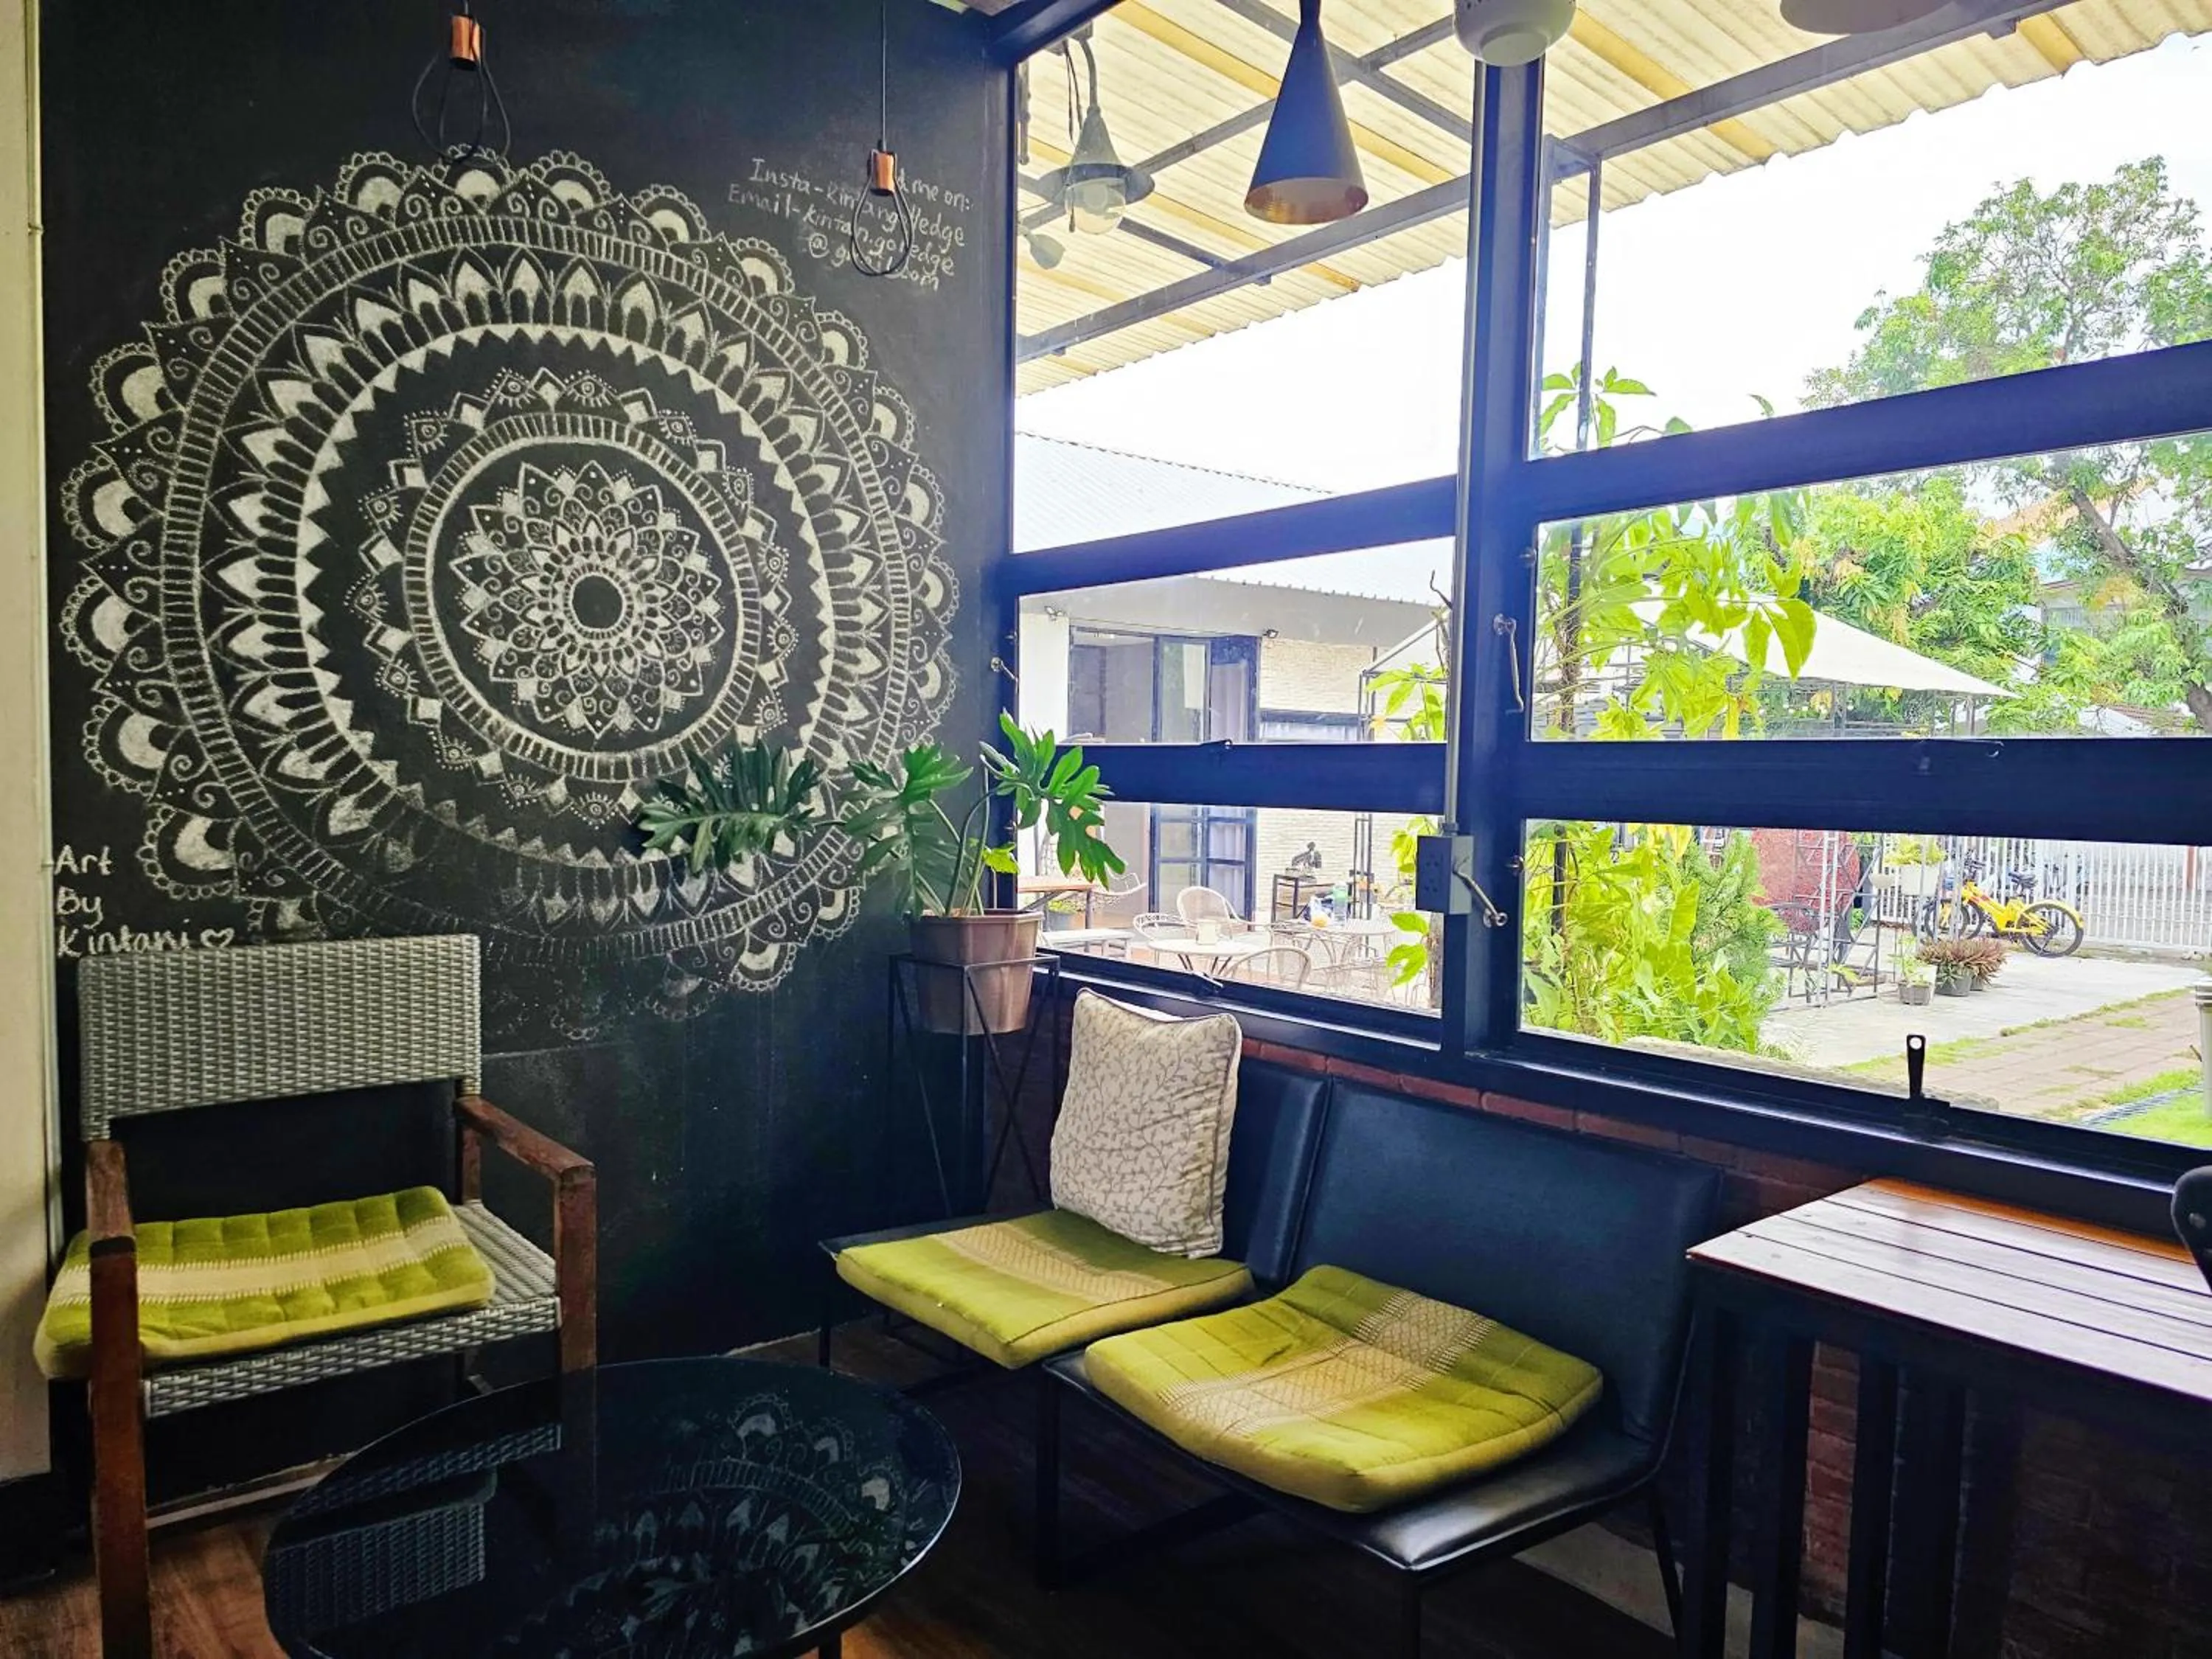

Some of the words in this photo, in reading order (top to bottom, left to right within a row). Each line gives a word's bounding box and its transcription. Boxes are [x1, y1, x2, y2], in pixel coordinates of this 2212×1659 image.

[911, 179, 939, 202] me
[55, 844, 113, 876] Art
[57, 886, 104, 930] By
